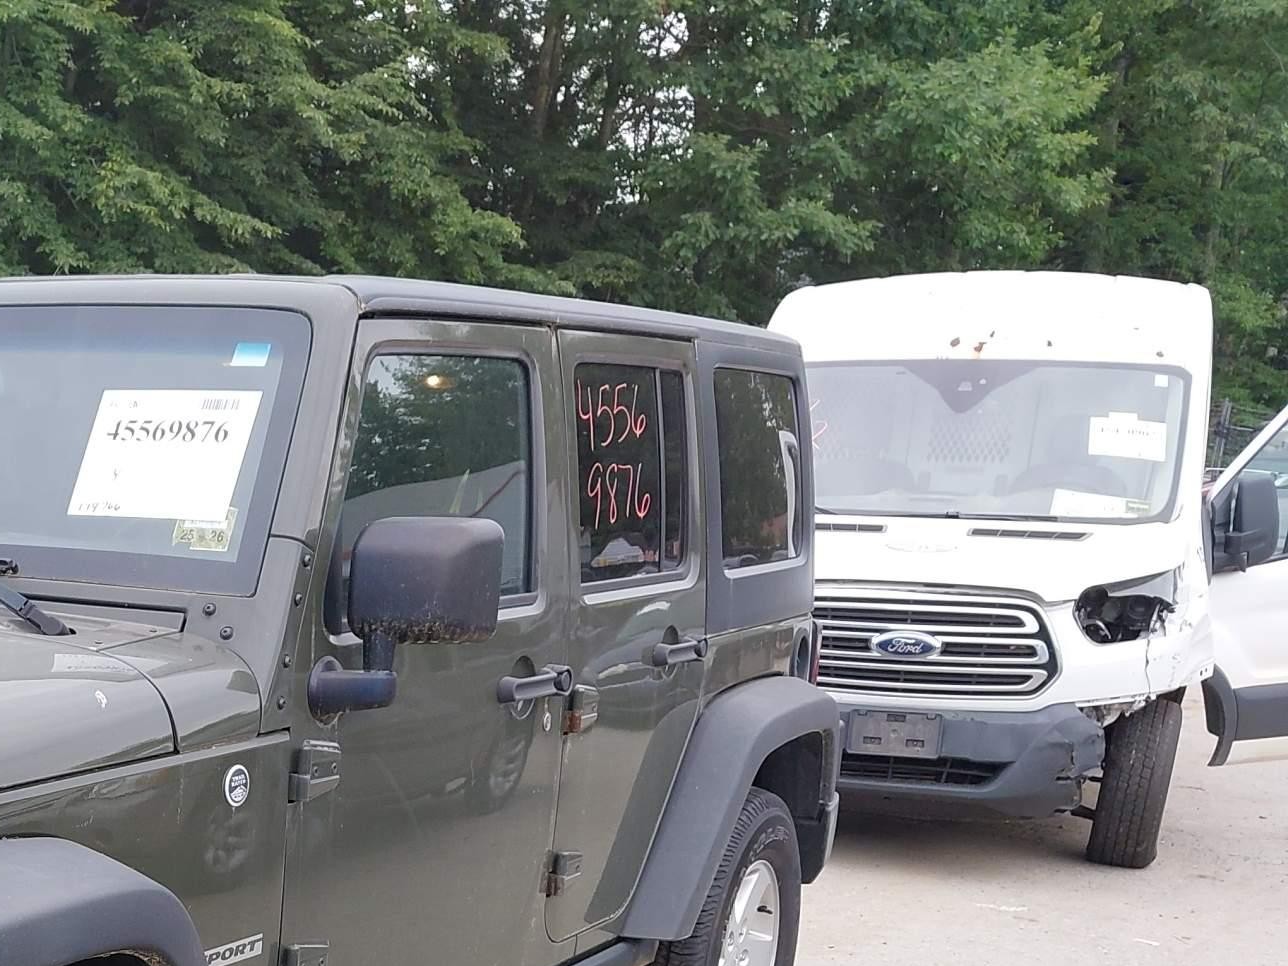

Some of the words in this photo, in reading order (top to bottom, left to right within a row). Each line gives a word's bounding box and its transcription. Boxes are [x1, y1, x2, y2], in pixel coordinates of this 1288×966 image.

[577, 379, 647, 451] 4556
[105, 419, 229, 443] 45569876
[587, 462, 651, 530] 9876
[179, 528, 194, 542] 25
[209, 529, 225, 544] 26
[887, 638, 924, 654] Ford
[206, 938, 262, 965] PORT
